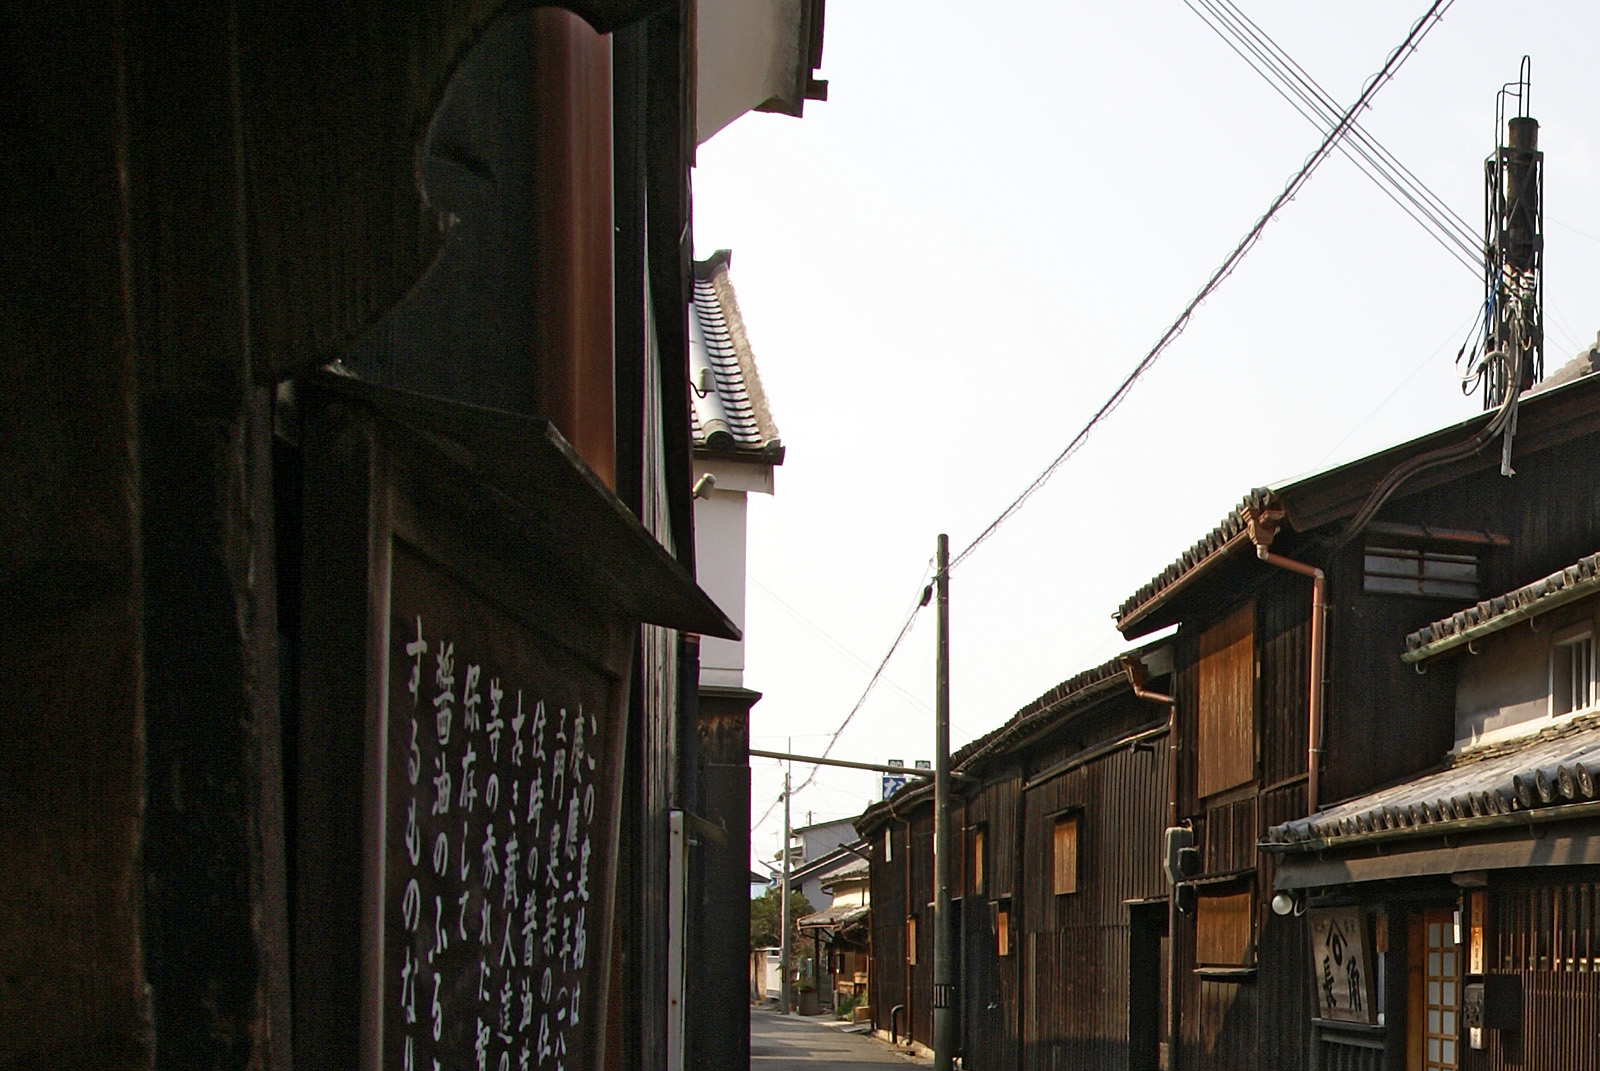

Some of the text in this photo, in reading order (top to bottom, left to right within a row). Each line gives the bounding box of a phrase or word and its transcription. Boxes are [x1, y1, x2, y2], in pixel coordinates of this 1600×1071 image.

[458, 664, 480, 941] 保存して
[570, 713, 597, 1026] この建物は
